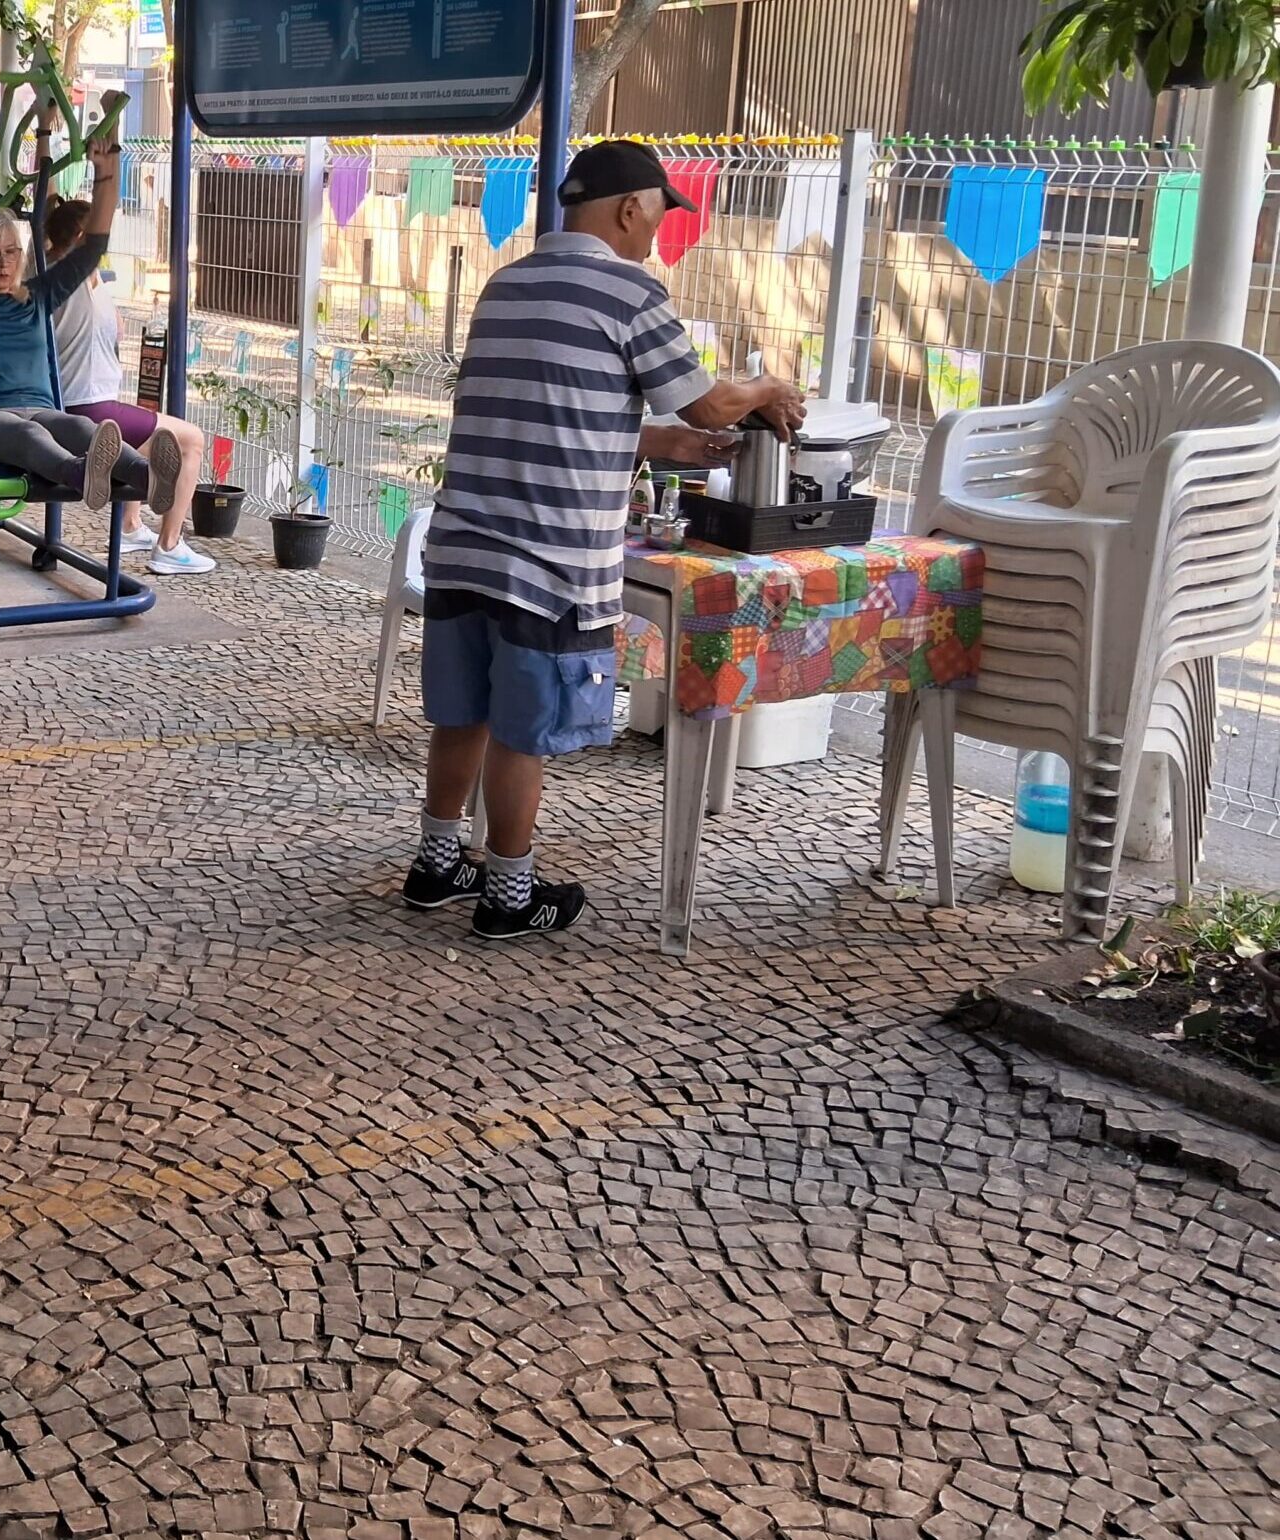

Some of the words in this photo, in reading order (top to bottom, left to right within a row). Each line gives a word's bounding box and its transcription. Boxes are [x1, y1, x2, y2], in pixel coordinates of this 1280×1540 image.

[410, 90, 419, 99] DE
[420, 88, 450, 99] VISITÁ-LO
[453, 86, 510, 97] REGULARMENTE.
